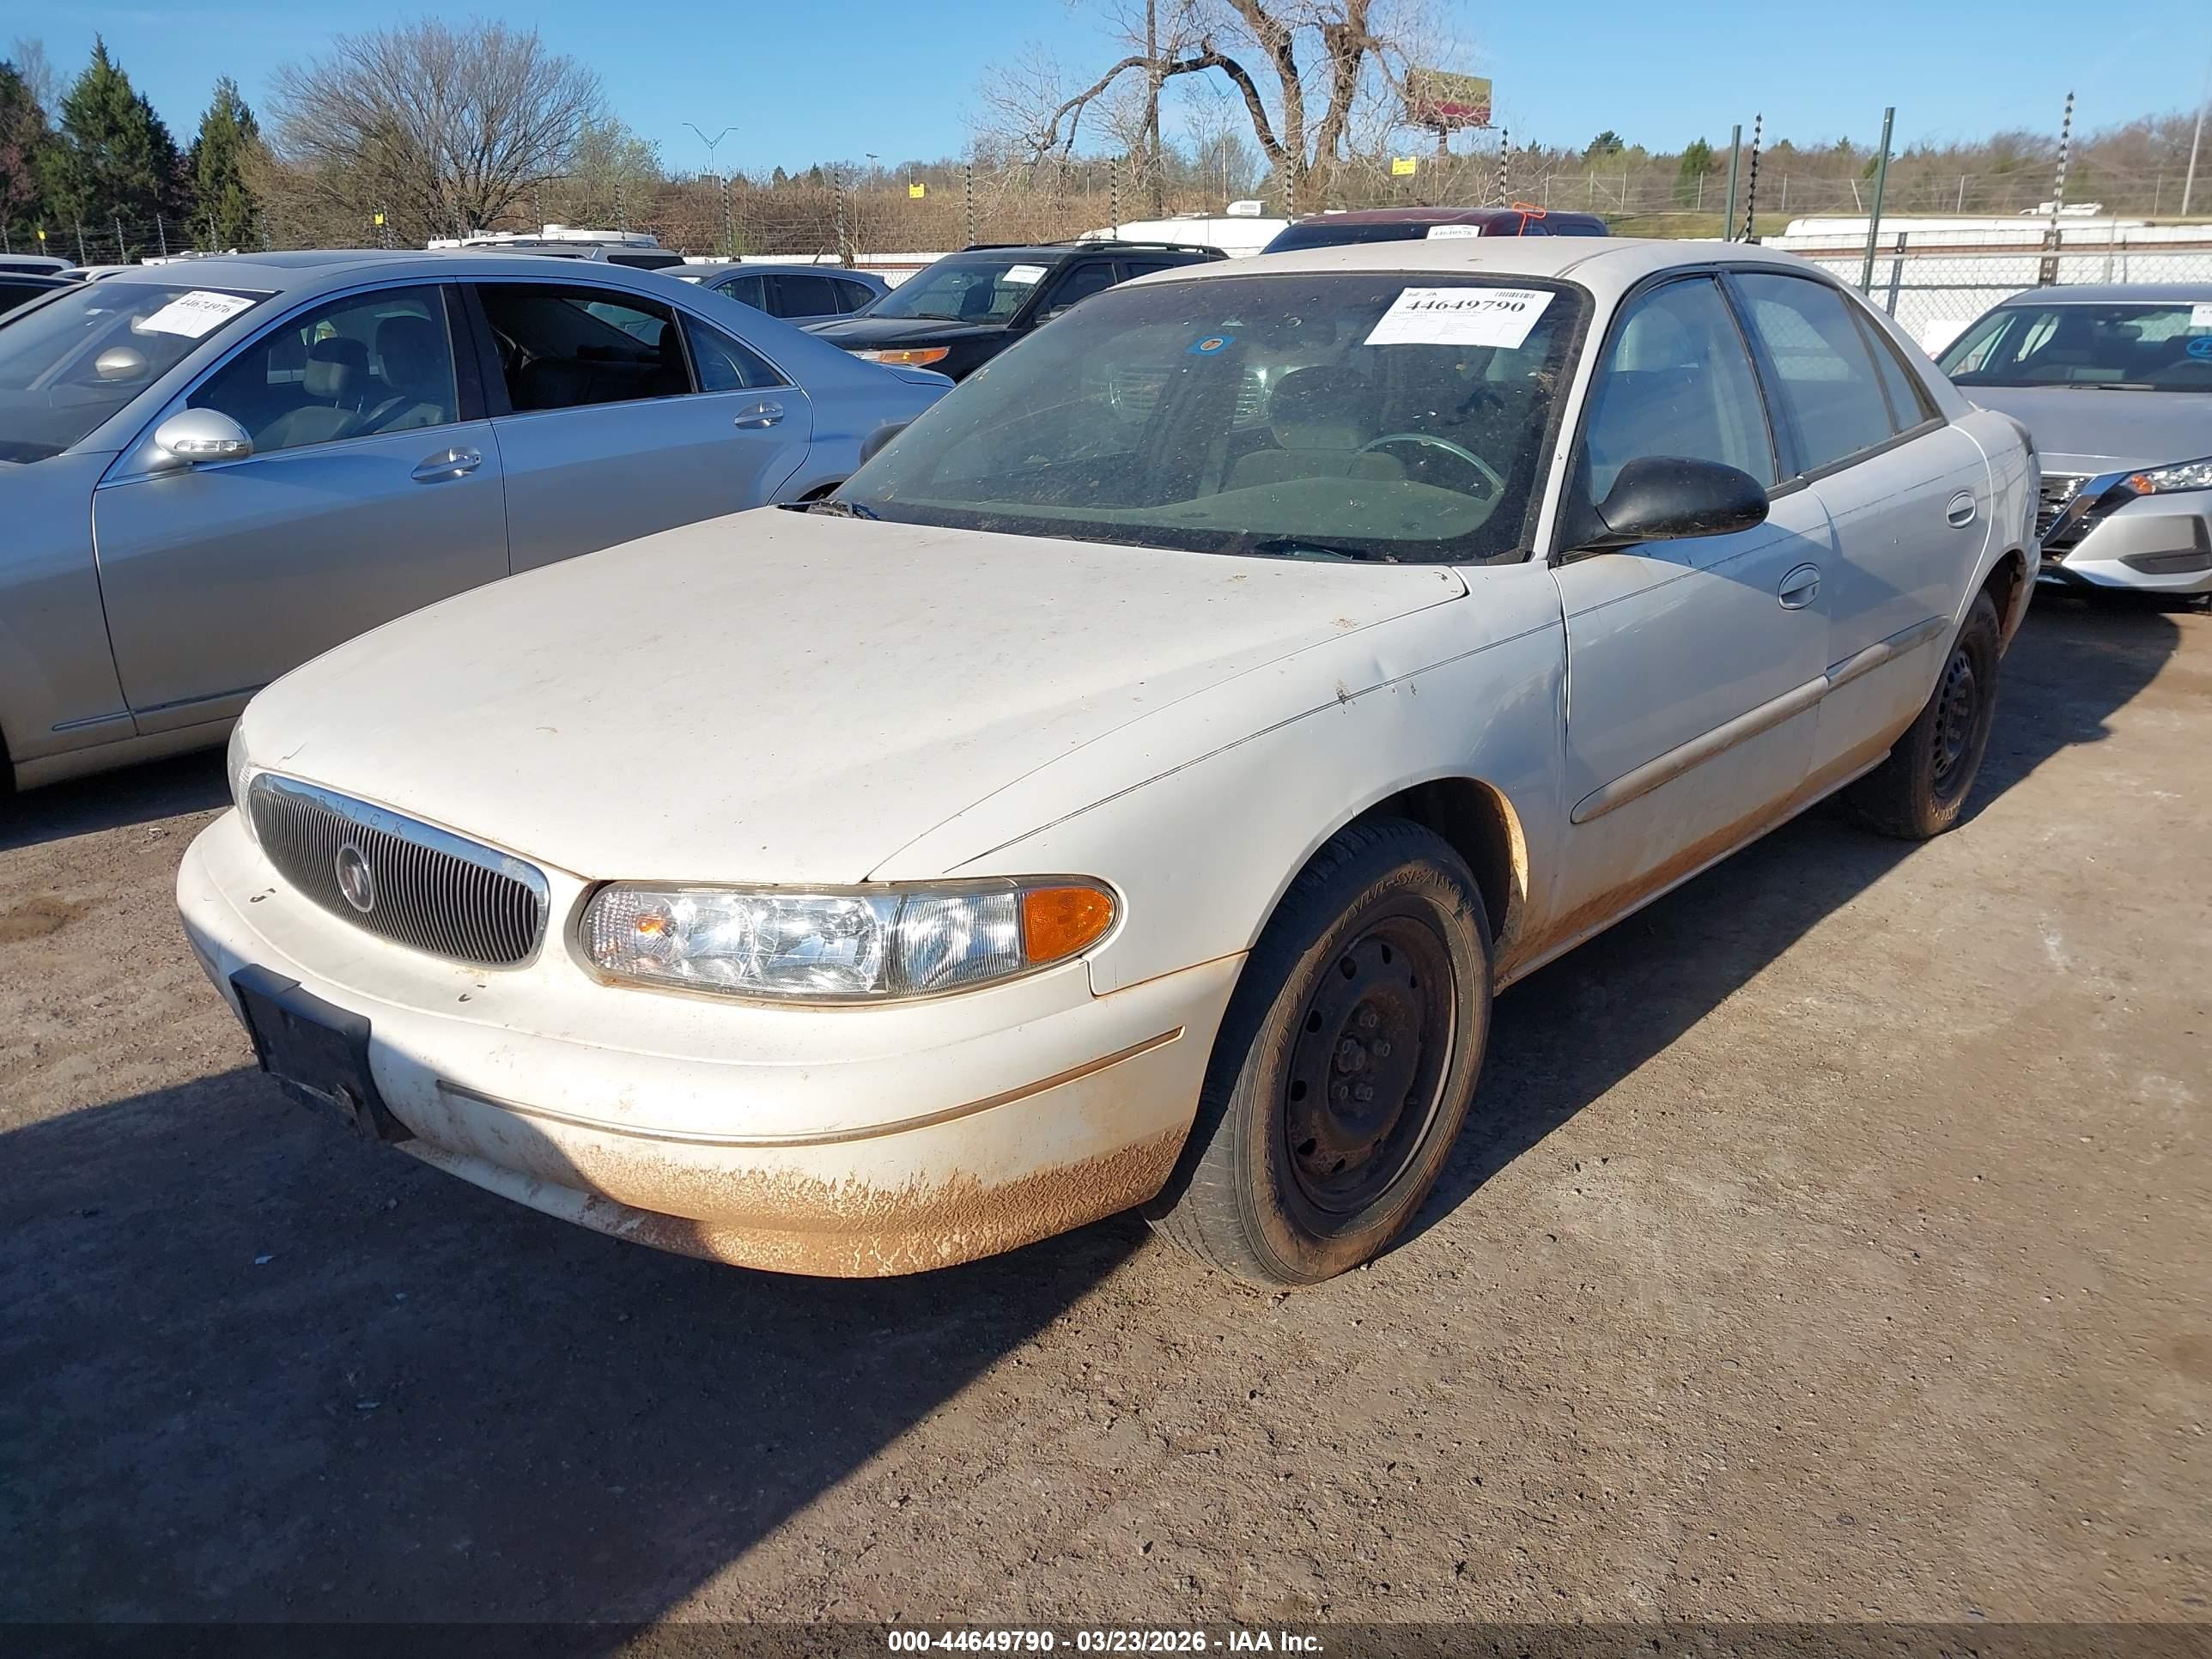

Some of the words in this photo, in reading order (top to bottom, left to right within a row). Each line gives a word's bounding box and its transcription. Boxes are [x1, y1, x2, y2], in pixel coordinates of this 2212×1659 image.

[180, 299, 234, 313] 44674976
[1405, 300, 1526, 313] 44649790
[317, 794, 404, 836] BUICK
[1268, 970, 1315, 1076] VIVA
